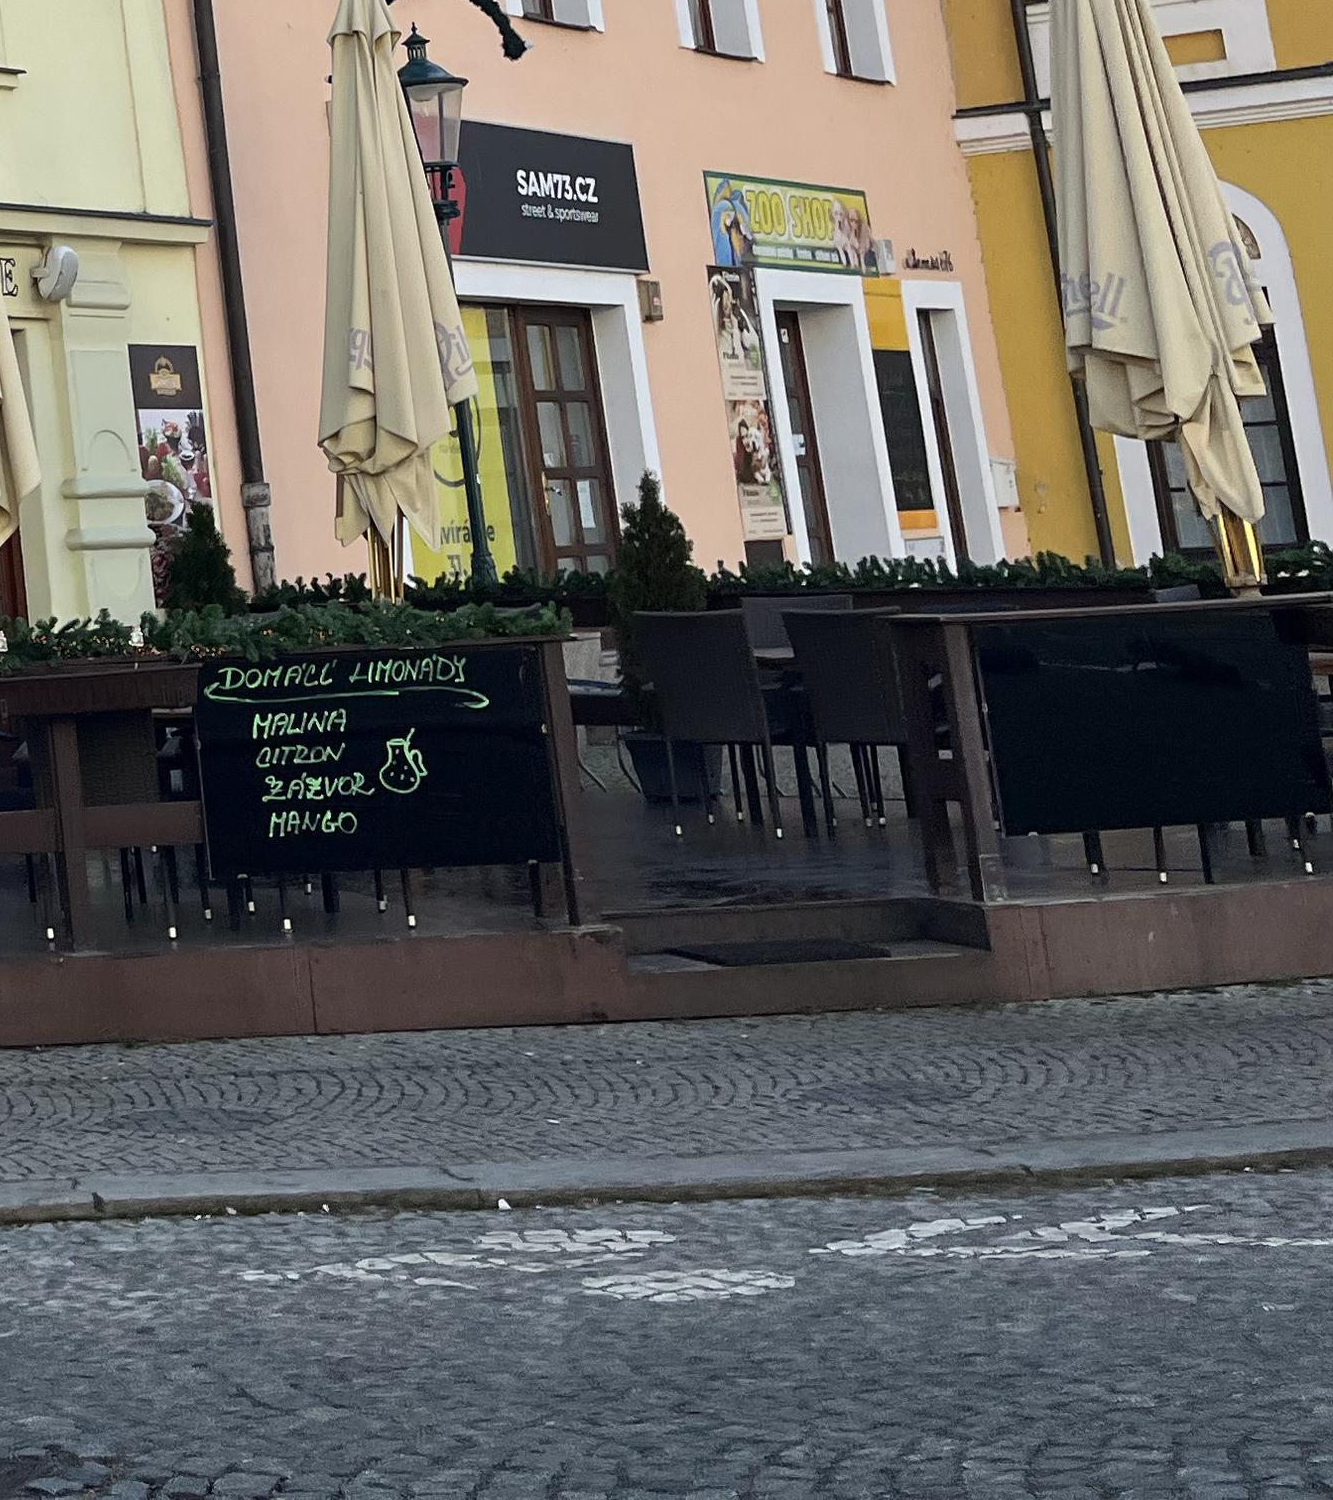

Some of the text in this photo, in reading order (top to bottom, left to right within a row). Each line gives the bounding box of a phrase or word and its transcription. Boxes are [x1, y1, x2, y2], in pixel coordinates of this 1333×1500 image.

[516, 169, 599, 203] SAM73.CZ
[521, 203, 599, 223] street & sportswear
[745, 189, 786, 237] ZOO
[349, 655, 467, 684] LIMONÁDY
[252, 708, 347, 740] MALINA
[255, 742, 346, 768] CITRON
[262, 772, 375, 802] ZÁZVOR
[268, 810, 358, 838] MANGO
